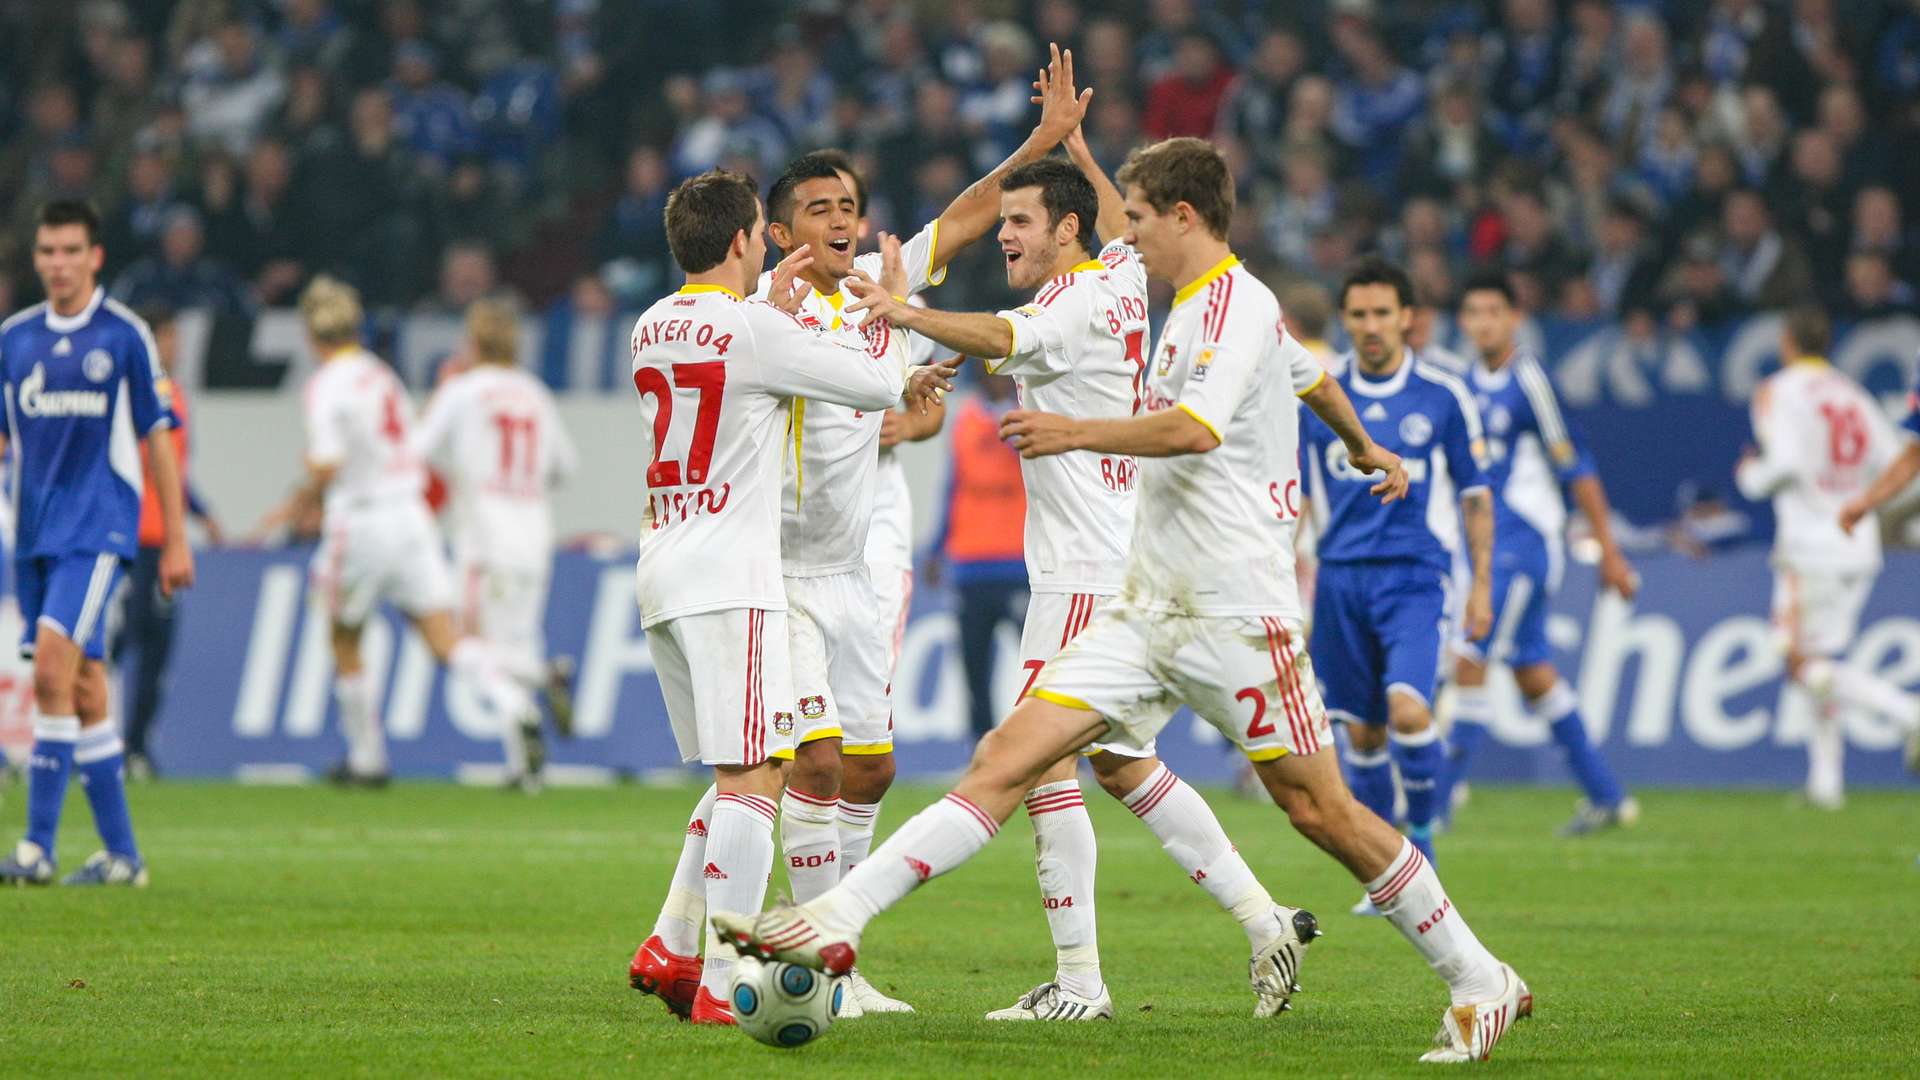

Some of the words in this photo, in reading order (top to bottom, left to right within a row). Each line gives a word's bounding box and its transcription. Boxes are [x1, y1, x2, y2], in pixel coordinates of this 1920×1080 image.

[696, 323, 733, 356] 04
[633, 361, 727, 489] 27
[1235, 686, 1276, 739] 2
